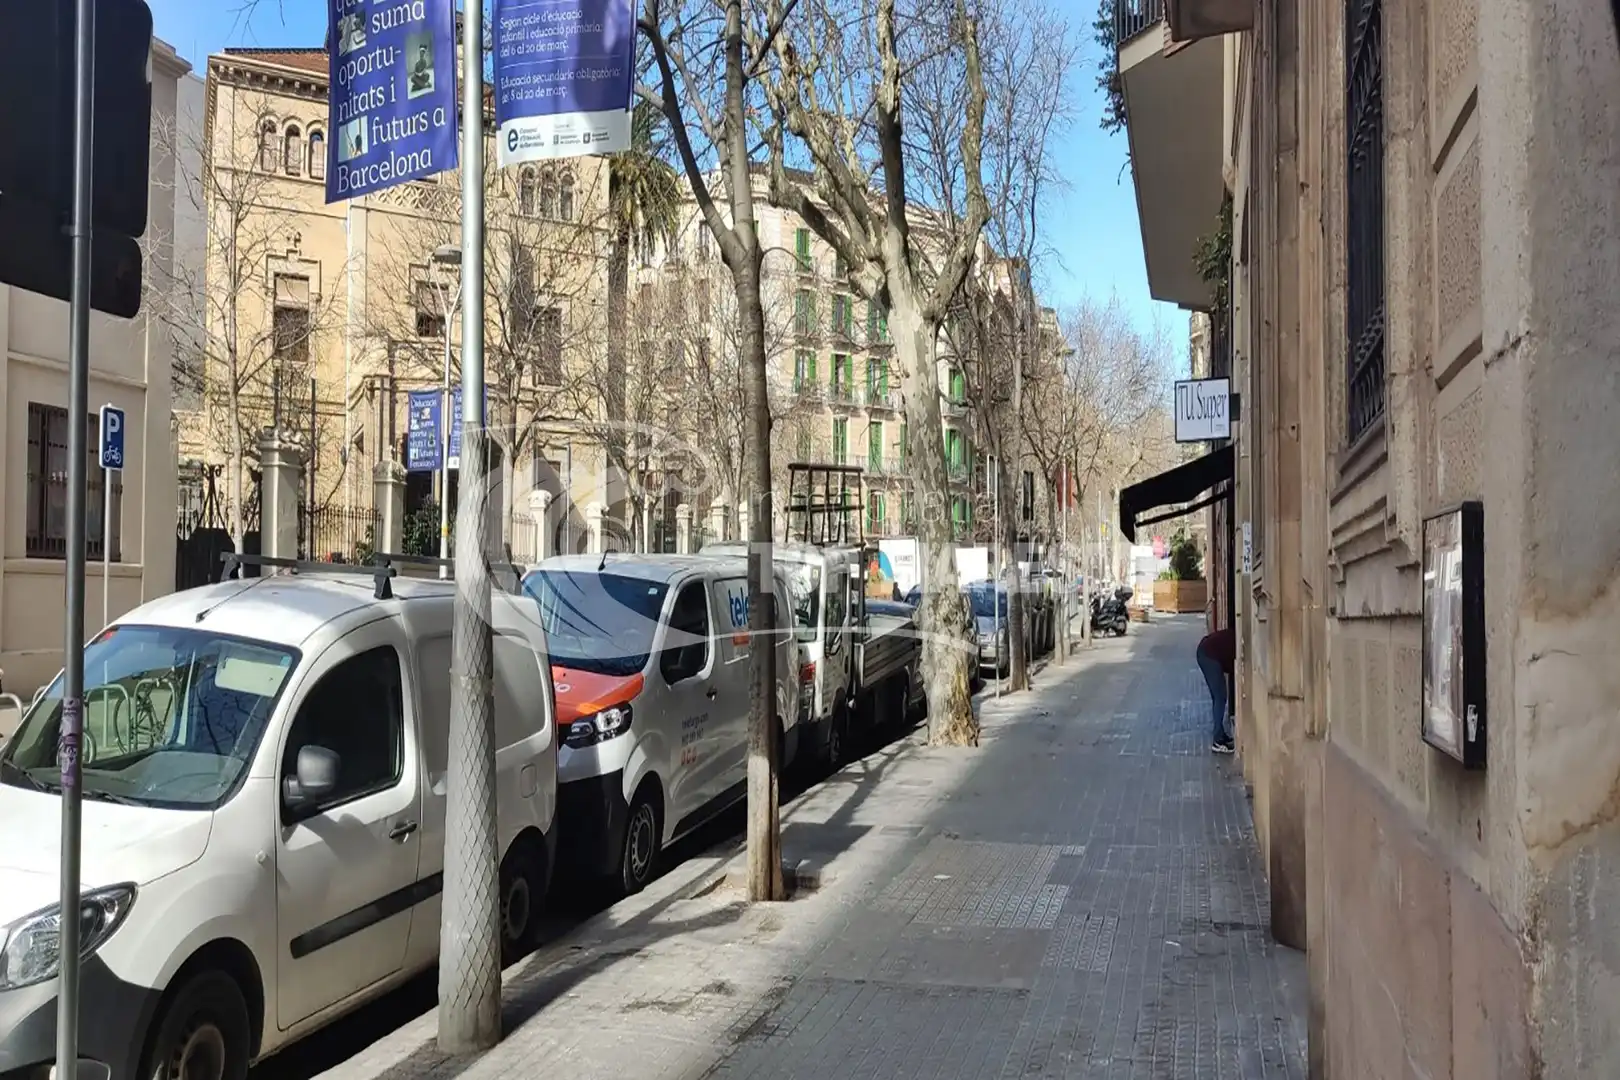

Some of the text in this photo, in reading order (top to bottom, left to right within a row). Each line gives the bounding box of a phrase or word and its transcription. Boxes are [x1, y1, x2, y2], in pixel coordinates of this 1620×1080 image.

[372, 0, 425, 33] suma
[339, 46, 401, 90] oportu-
[339, 76, 396, 123] nitats i
[372, 106, 446, 146] futurs a
[337, 148, 432, 194] Barcelona
[106, 412, 120, 442] P
